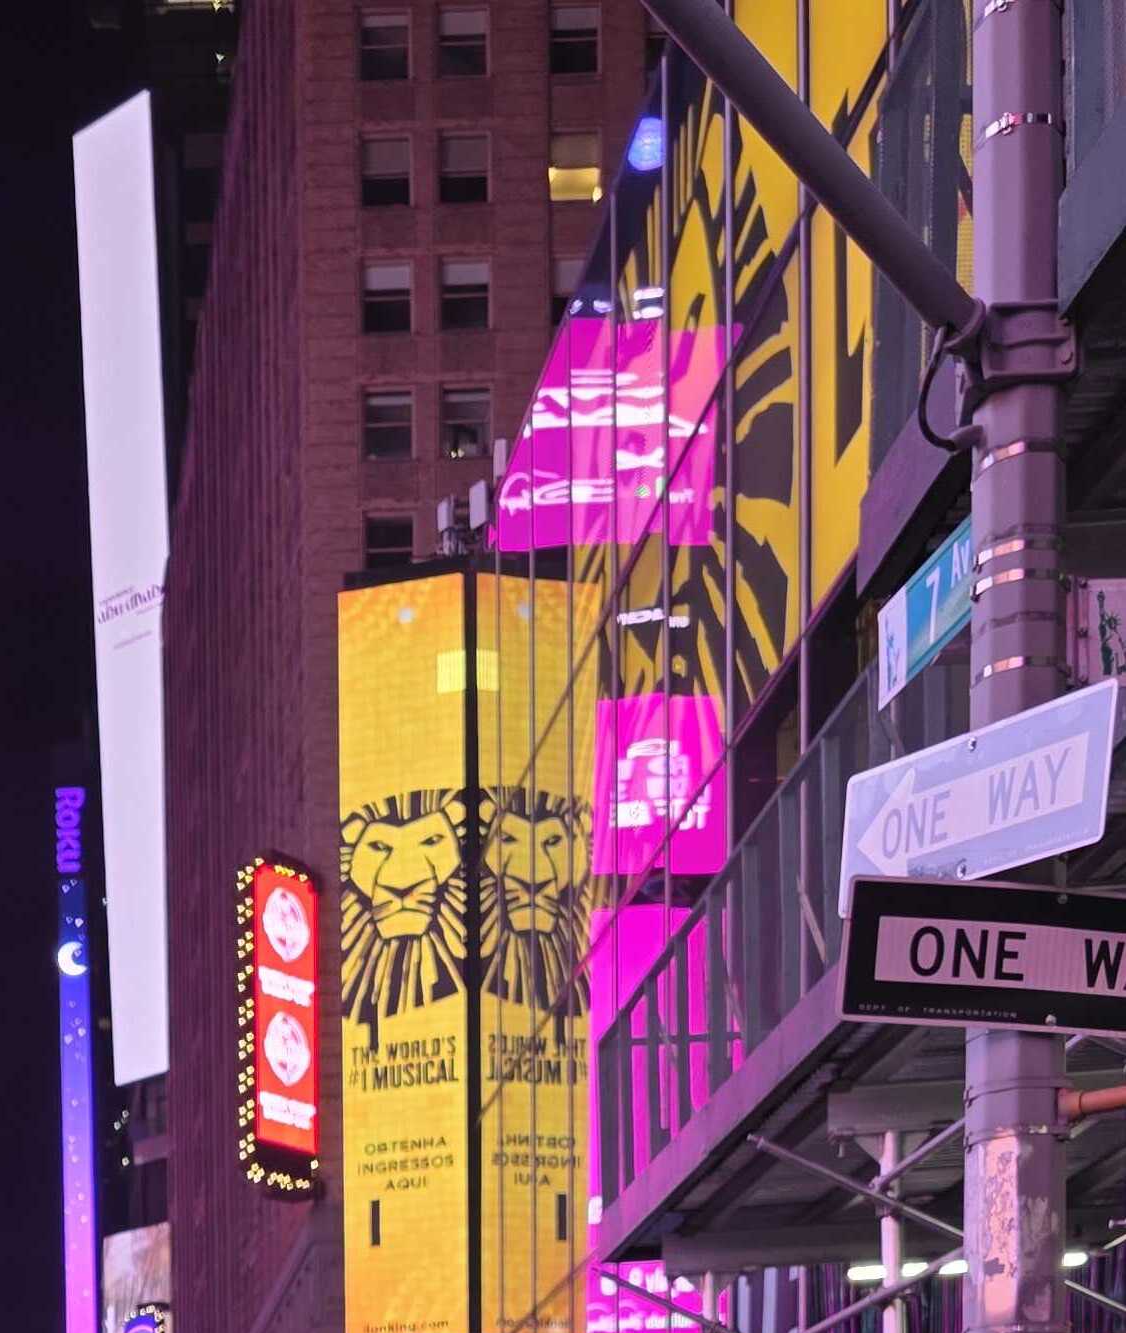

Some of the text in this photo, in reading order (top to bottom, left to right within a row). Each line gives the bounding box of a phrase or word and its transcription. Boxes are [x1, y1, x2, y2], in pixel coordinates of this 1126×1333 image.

[925, 565, 942, 645] 7
[882, 790, 952, 860] ONE
[988, 746, 1073, 826] WAY
[908, 925, 1028, 982] ONE
[351, 1035, 457, 1065] THE WORLD'S
[373, 1057, 459, 1091] MUSICAL
[364, 1135, 447, 1156] OBTENHA
[357, 1155, 454, 1177] INGRESSOS
[385, 1176, 427, 1191] AQUI
